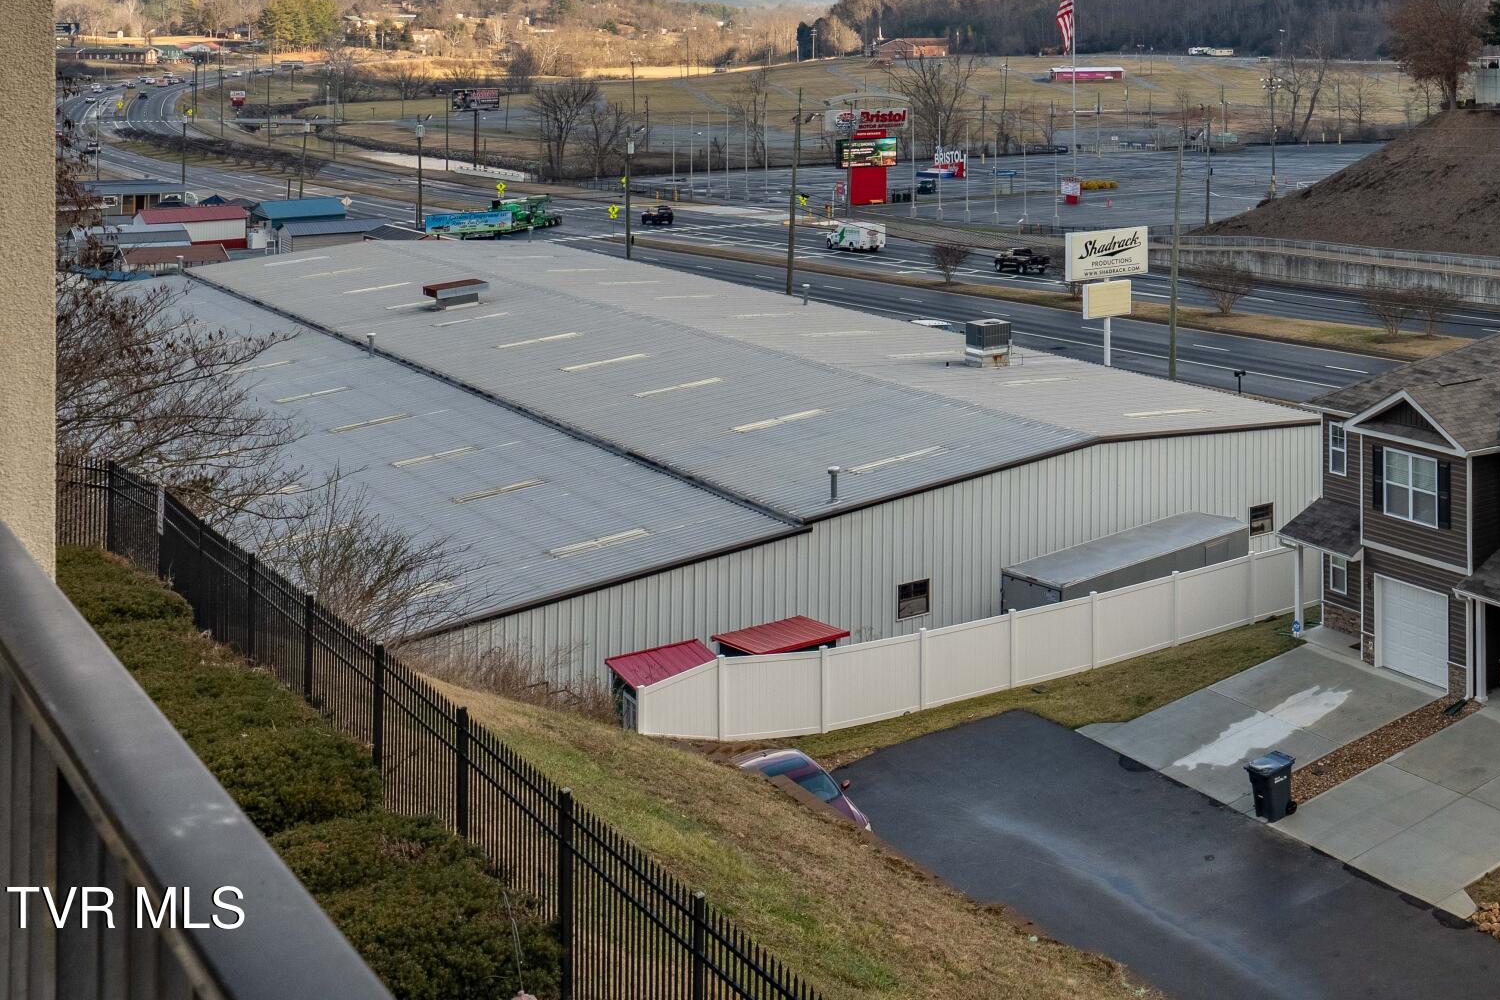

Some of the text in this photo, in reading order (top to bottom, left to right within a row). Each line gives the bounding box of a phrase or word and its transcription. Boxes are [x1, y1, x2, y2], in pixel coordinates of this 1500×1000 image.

[861, 109, 907, 123] Bristol
[934, 150, 964, 165] BRISTOL
[1078, 231, 1140, 259] Shadrack
[1091, 257, 1132, 267] PRODUCTIONS
